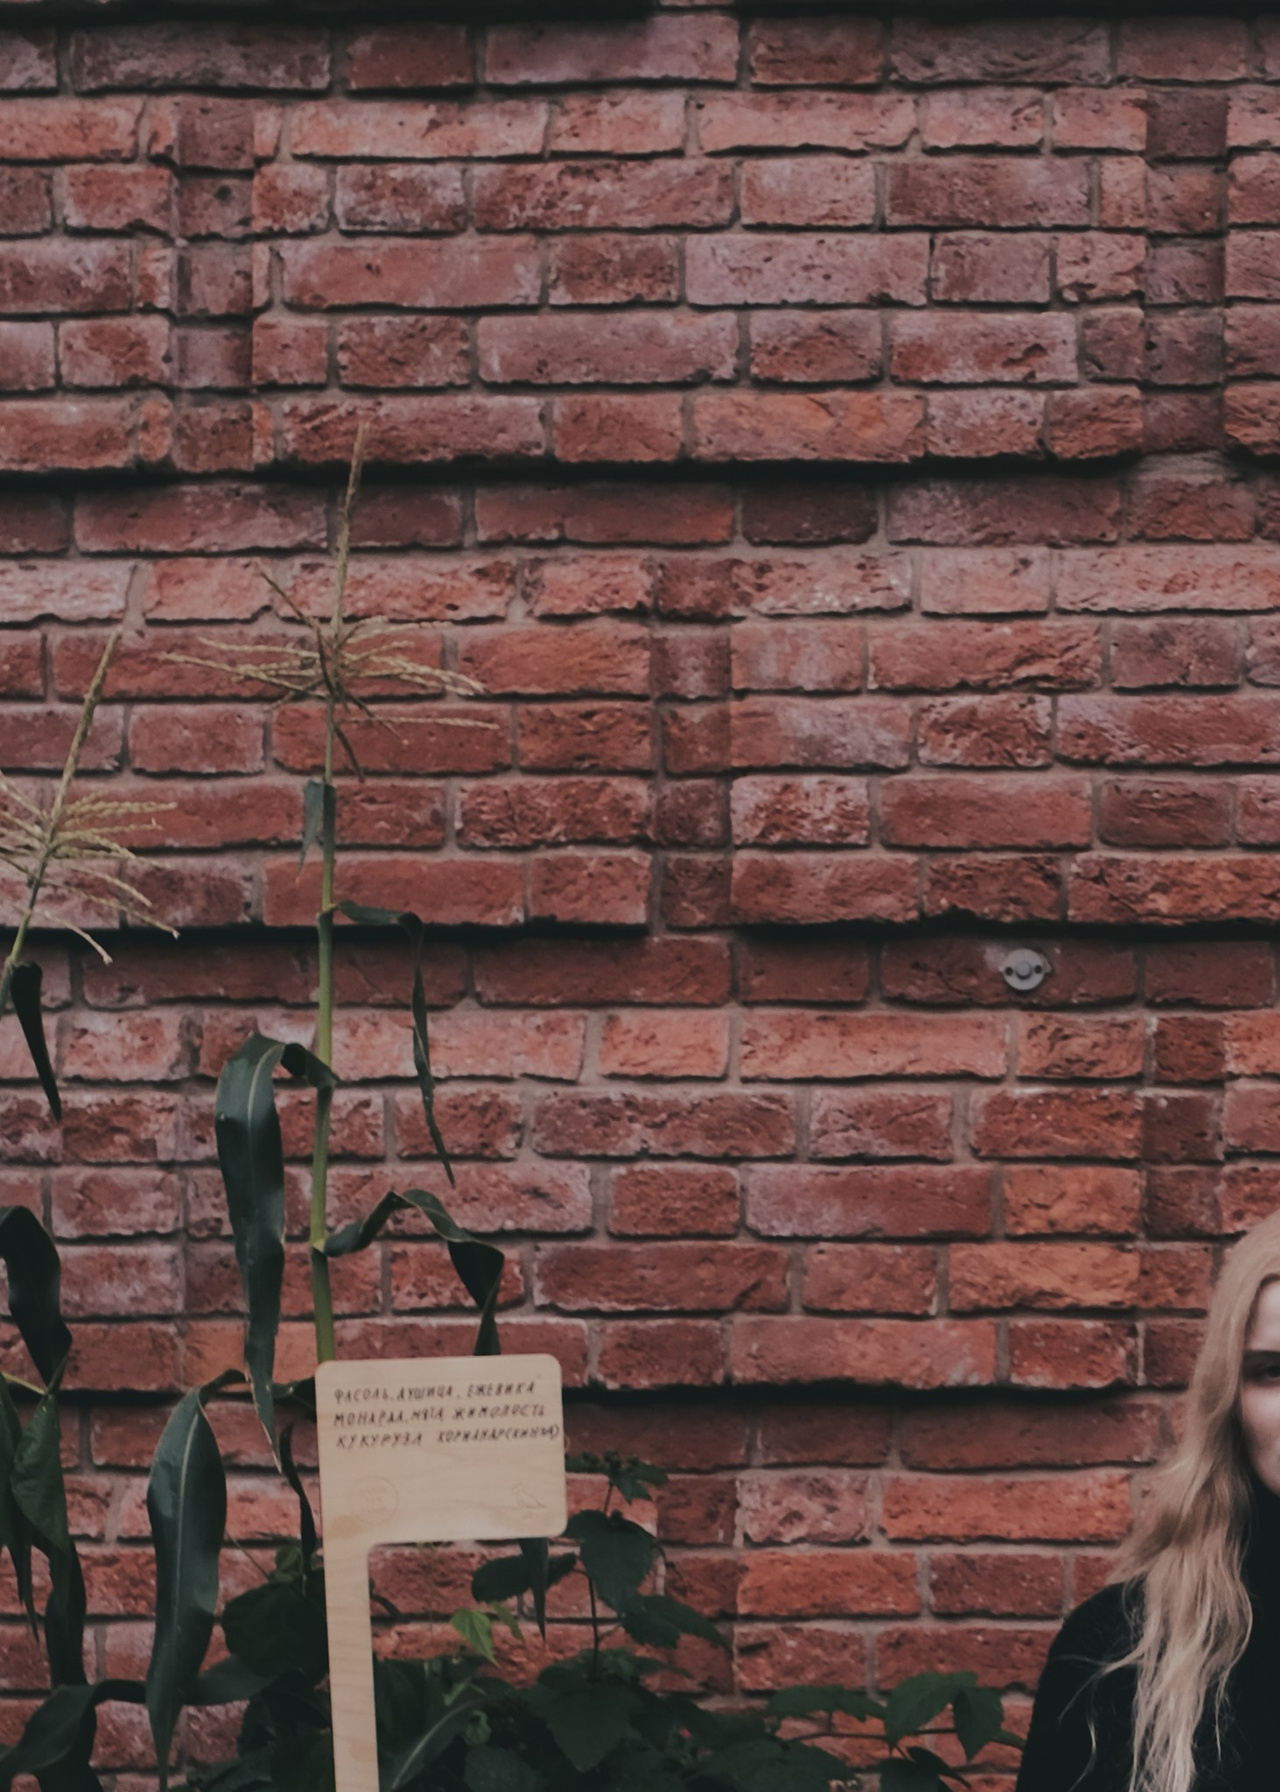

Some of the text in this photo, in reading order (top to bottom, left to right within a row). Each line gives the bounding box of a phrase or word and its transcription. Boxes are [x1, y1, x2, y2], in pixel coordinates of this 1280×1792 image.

[467, 1381, 535, 1398] ЕЖЕВИКА
[452, 1404, 545, 1421] ЖИМОЛОСТЬ
[336, 1431, 422, 1448] КУКУРУЗА
